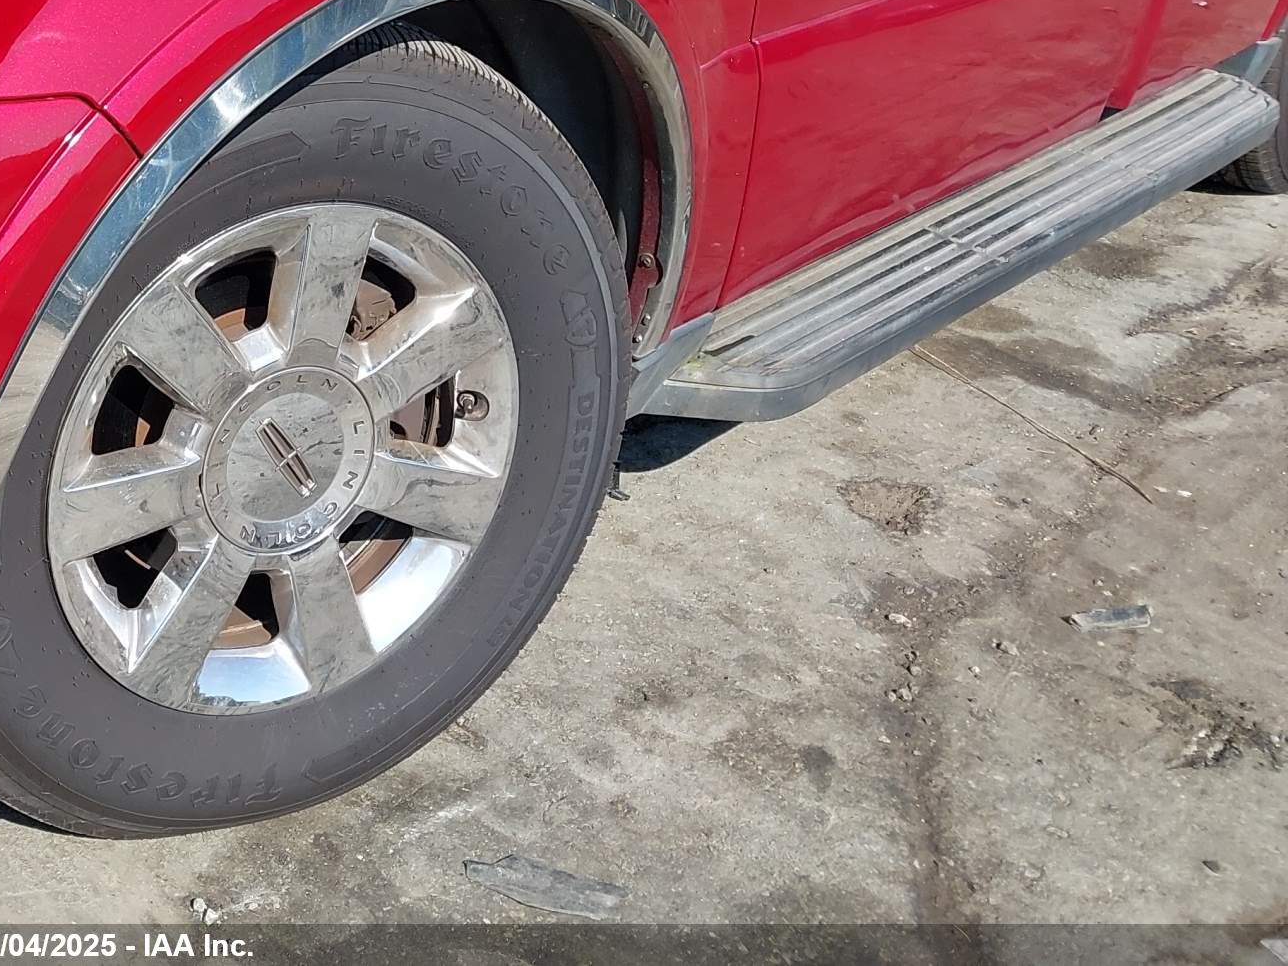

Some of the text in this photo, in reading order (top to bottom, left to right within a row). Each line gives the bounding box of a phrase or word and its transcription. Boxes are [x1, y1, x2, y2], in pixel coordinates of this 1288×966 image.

[331, 115, 570, 276] Firestone
[510, 391, 595, 613] DESTINATION
[14, 685, 283, 807] Firestone
